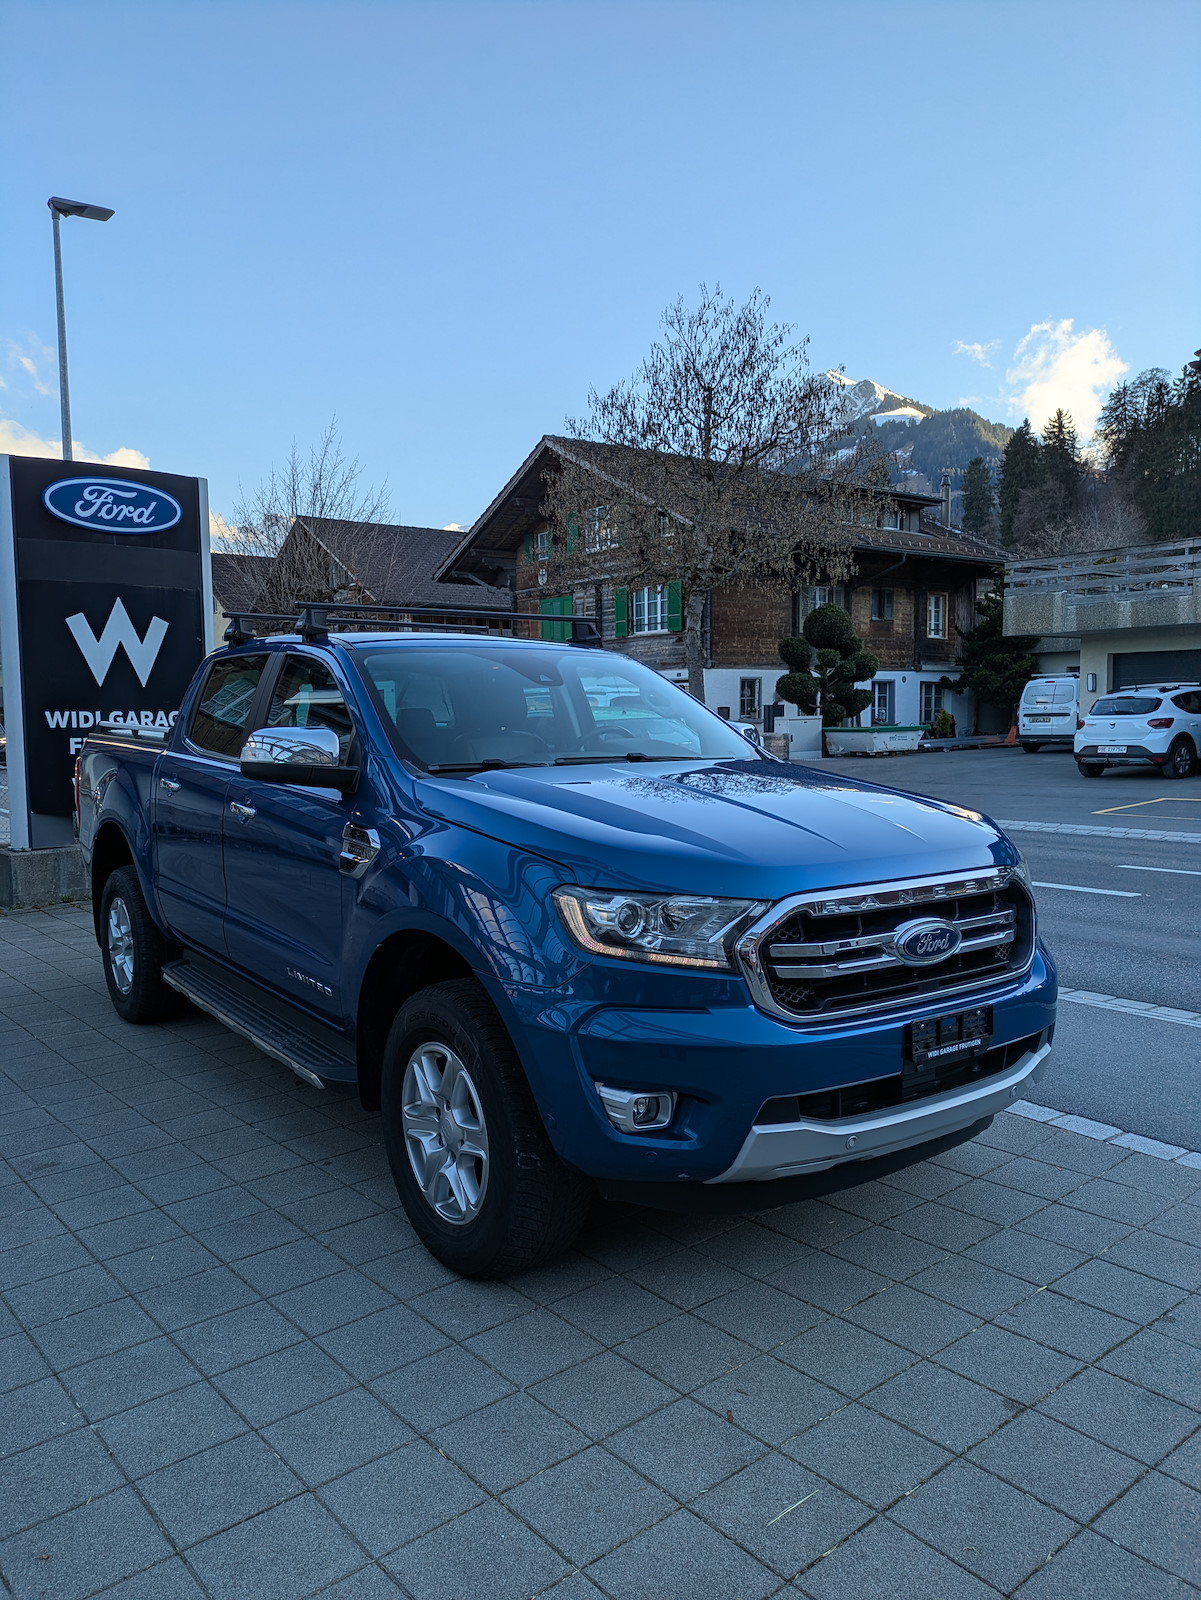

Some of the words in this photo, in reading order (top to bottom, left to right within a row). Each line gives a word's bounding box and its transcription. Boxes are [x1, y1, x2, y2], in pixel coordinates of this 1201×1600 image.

[74, 485, 156, 525] Ford
[65, 596, 169, 688] W
[916, 929, 950, 954] Ford
[287, 967, 333, 997] LIMITED
[927, 1049, 939, 1058] WIDI
[939, 1044, 958, 1055] GARAGE
[959, 1038, 981, 1050] FRUTIGEN
